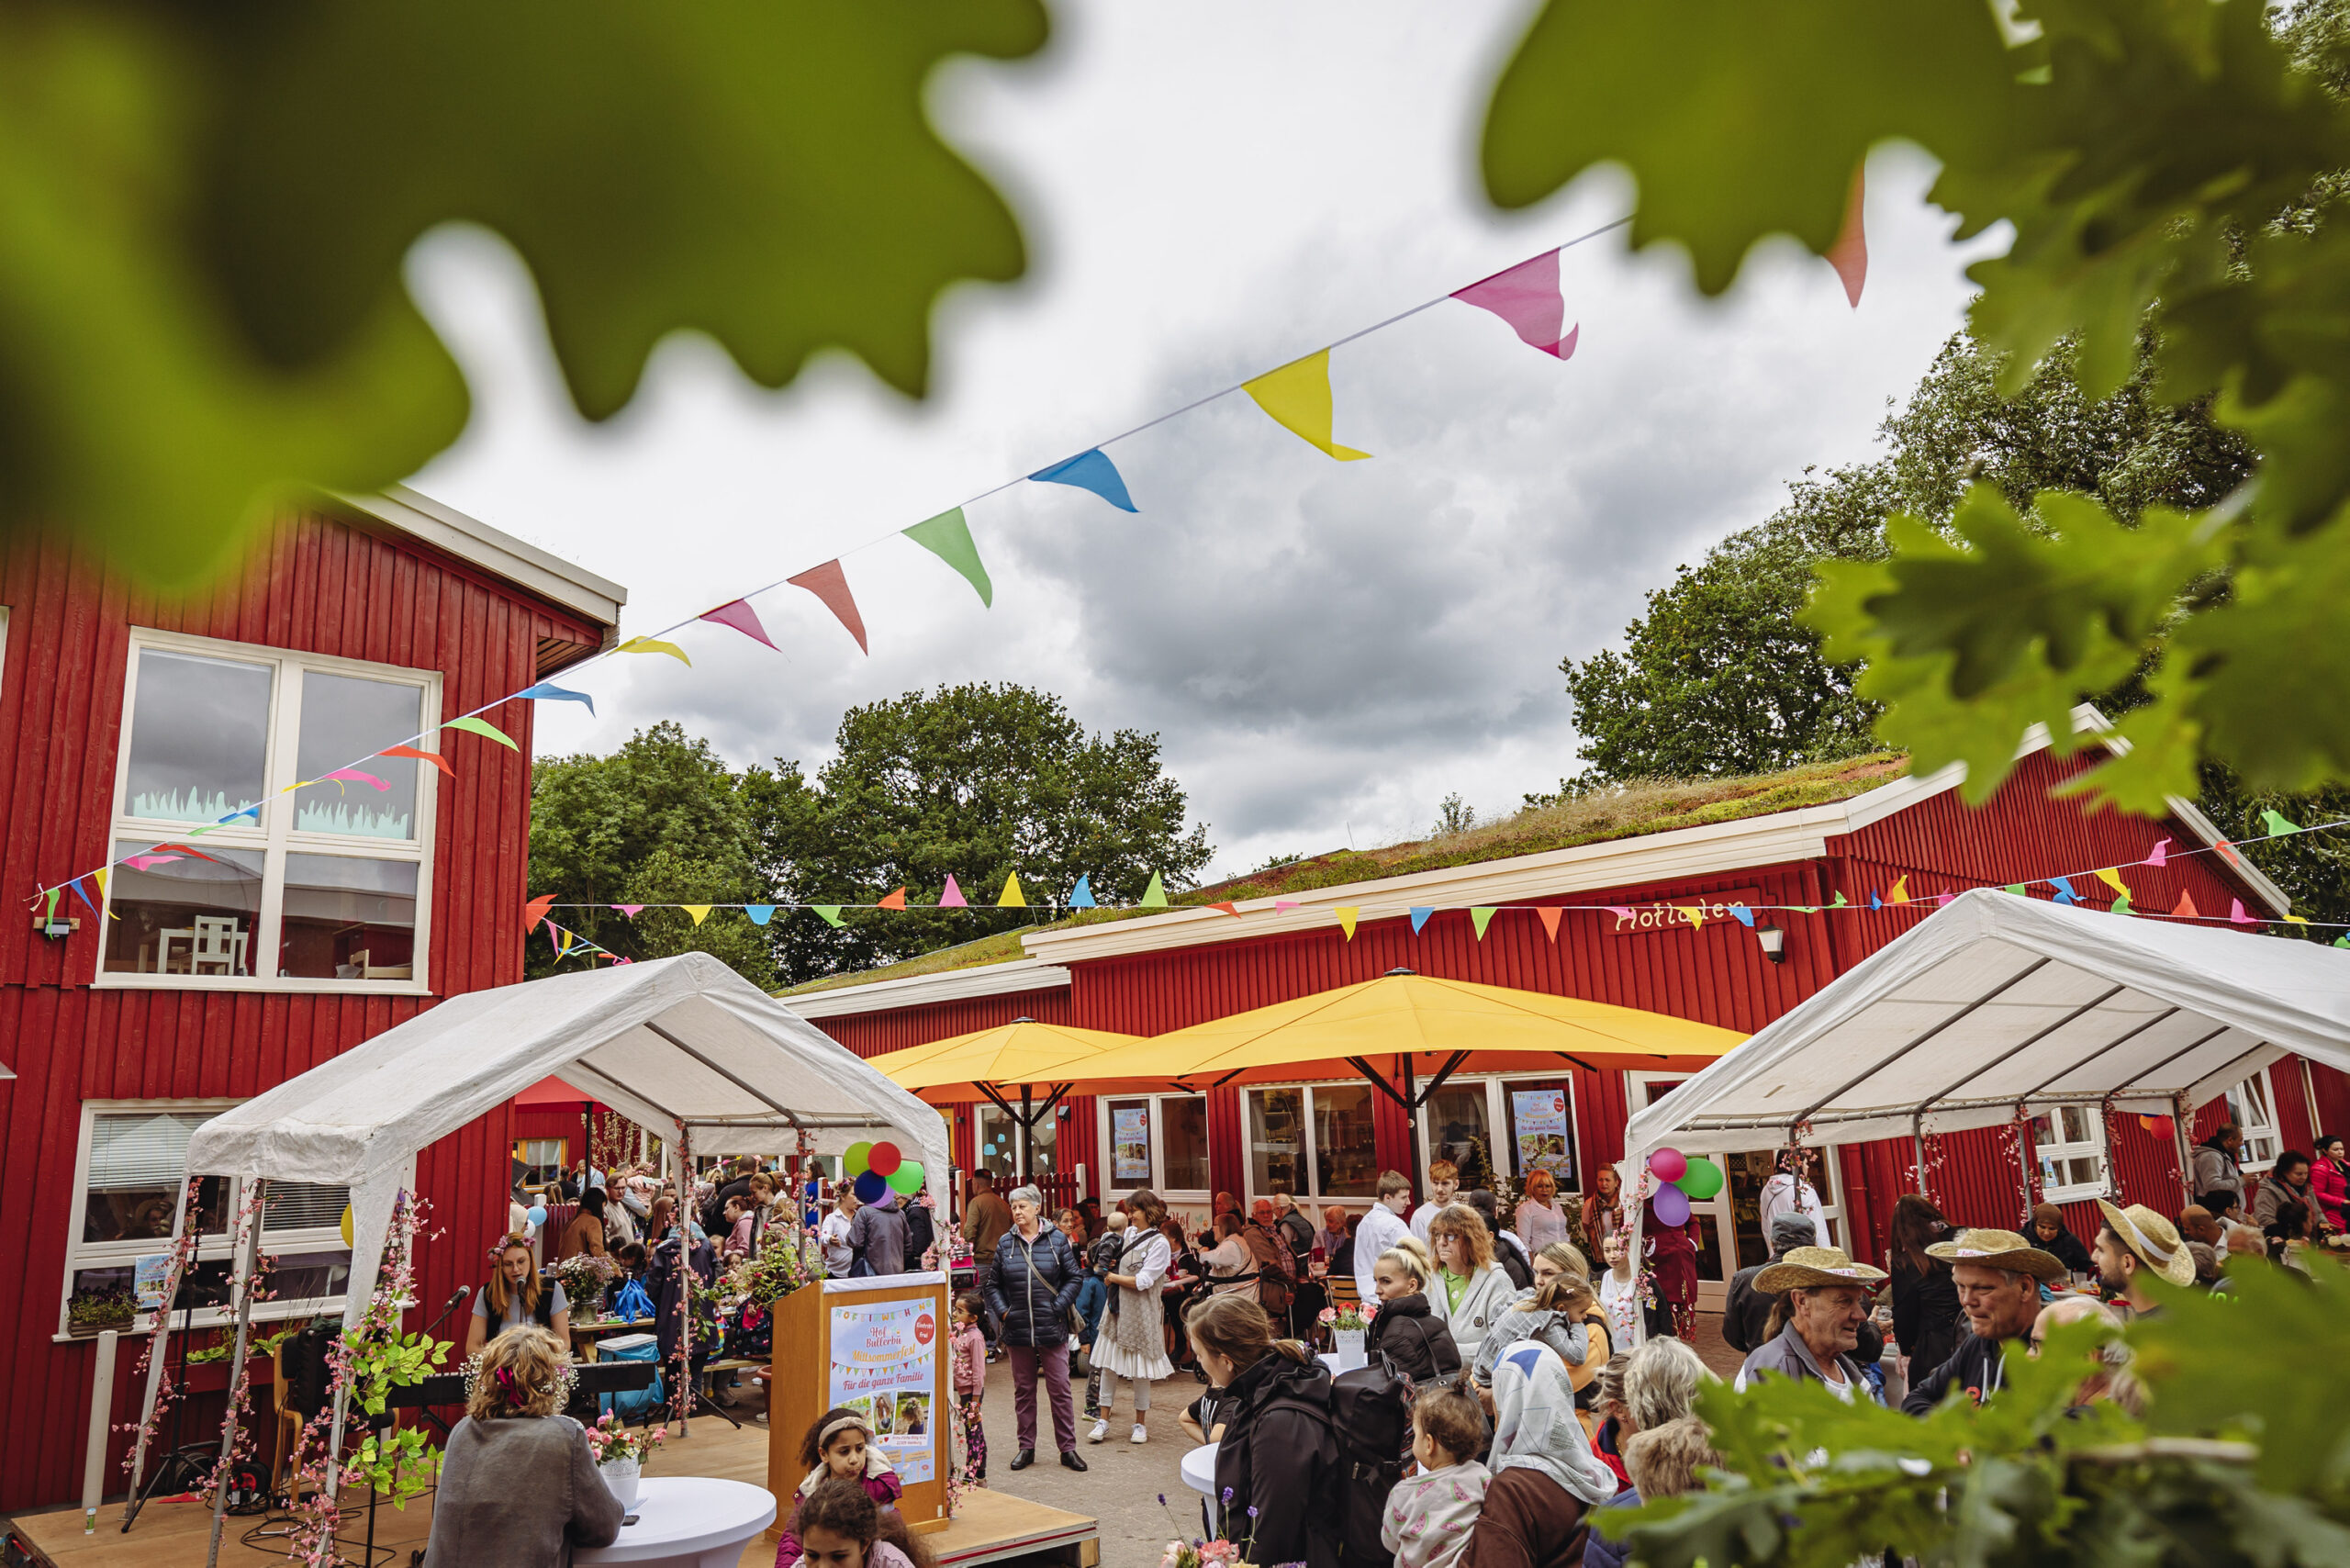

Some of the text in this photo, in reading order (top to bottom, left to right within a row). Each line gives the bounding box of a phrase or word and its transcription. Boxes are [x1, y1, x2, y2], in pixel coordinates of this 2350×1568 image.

[869, 1326, 888, 1338] Hof
[866, 1336, 901, 1348] Bullerbü
[852, 1343, 916, 1362] Mittsommerfest
[843, 1372, 924, 1391] Für die ganze Familie
